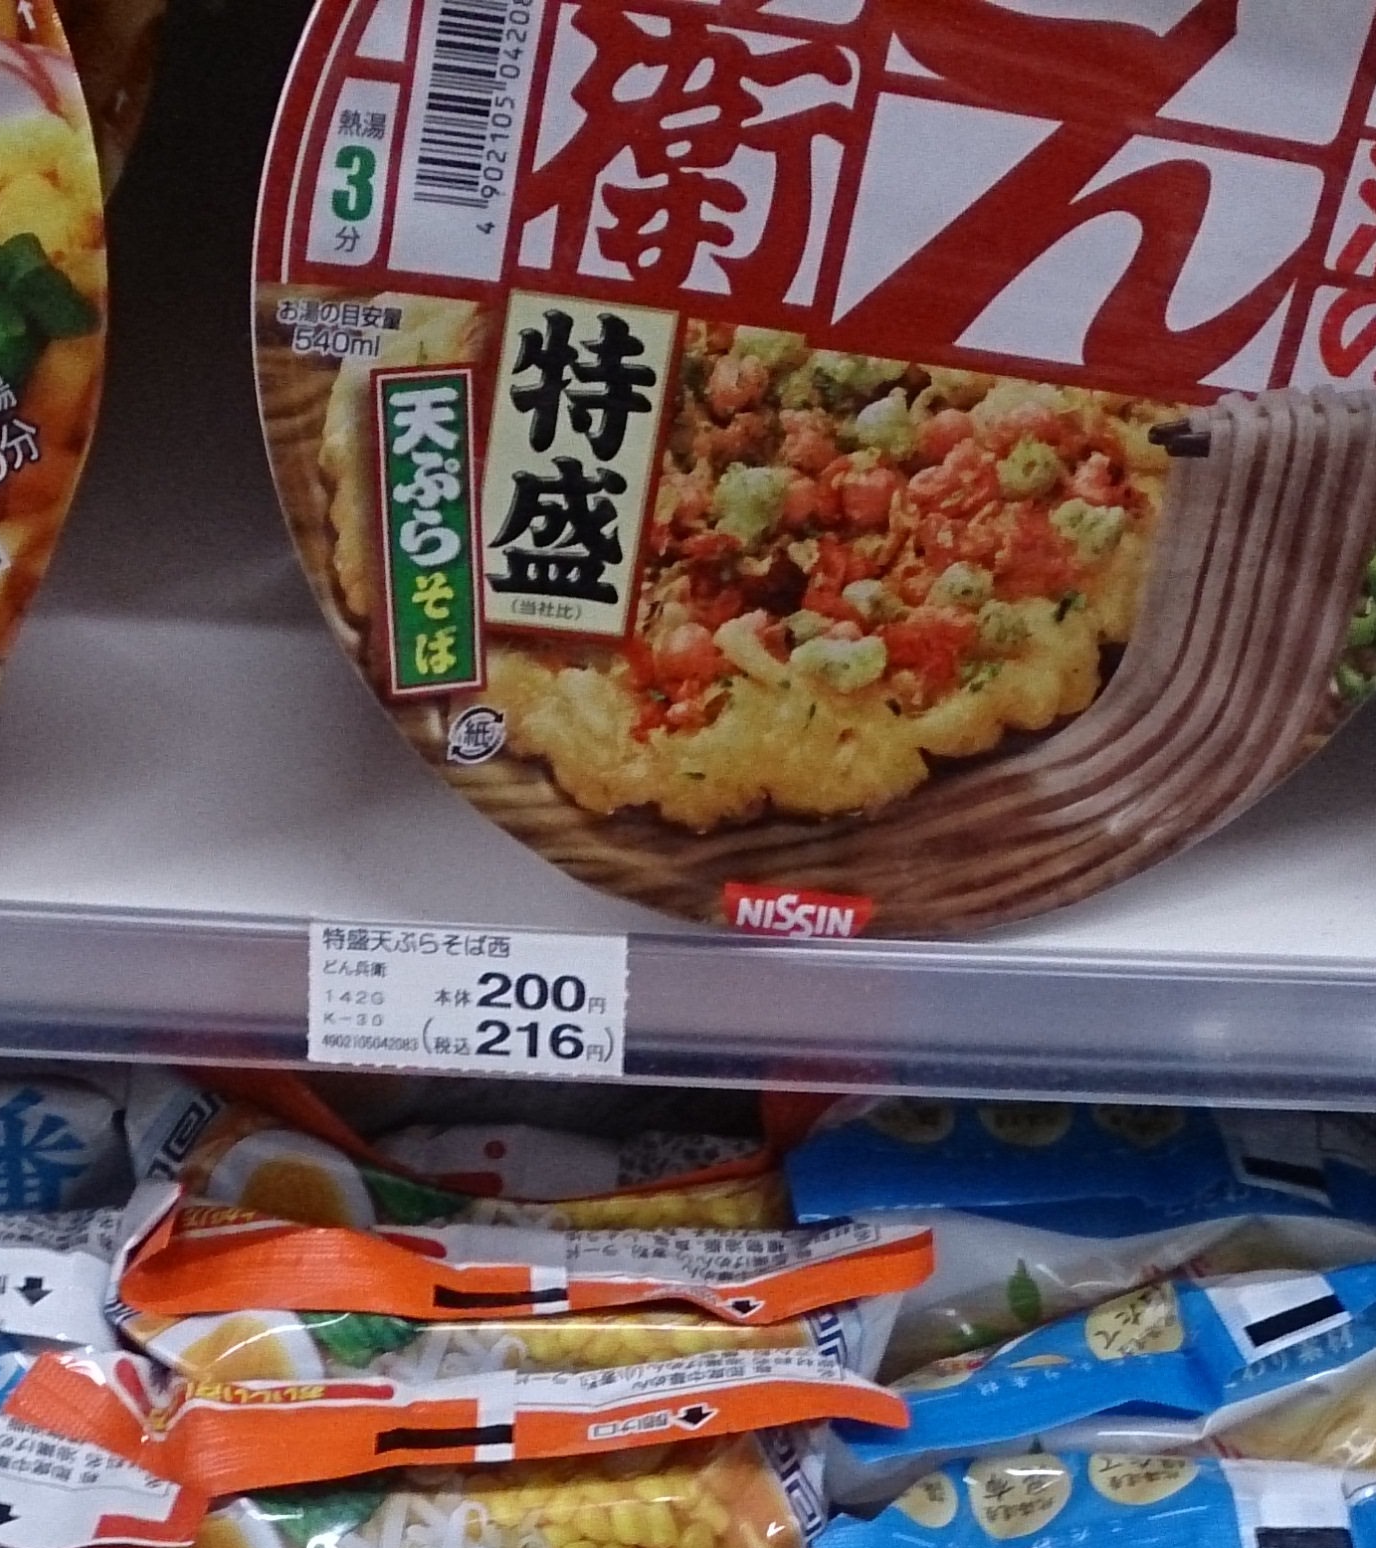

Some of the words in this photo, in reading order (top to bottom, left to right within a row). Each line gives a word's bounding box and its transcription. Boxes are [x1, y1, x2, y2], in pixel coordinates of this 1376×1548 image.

[338, 109, 387, 140] 熱湯
[331, 145, 376, 222] 3
[277, 300, 403, 332] お湯の目安量
[293, 327, 381, 359] 540ml
[488, 309, 657, 605] 特盛
[387, 386, 464, 676] 天ぷらそば
[736, 893, 856, 940] NISSIN
[323, 959, 387, 978] どん兵衛
